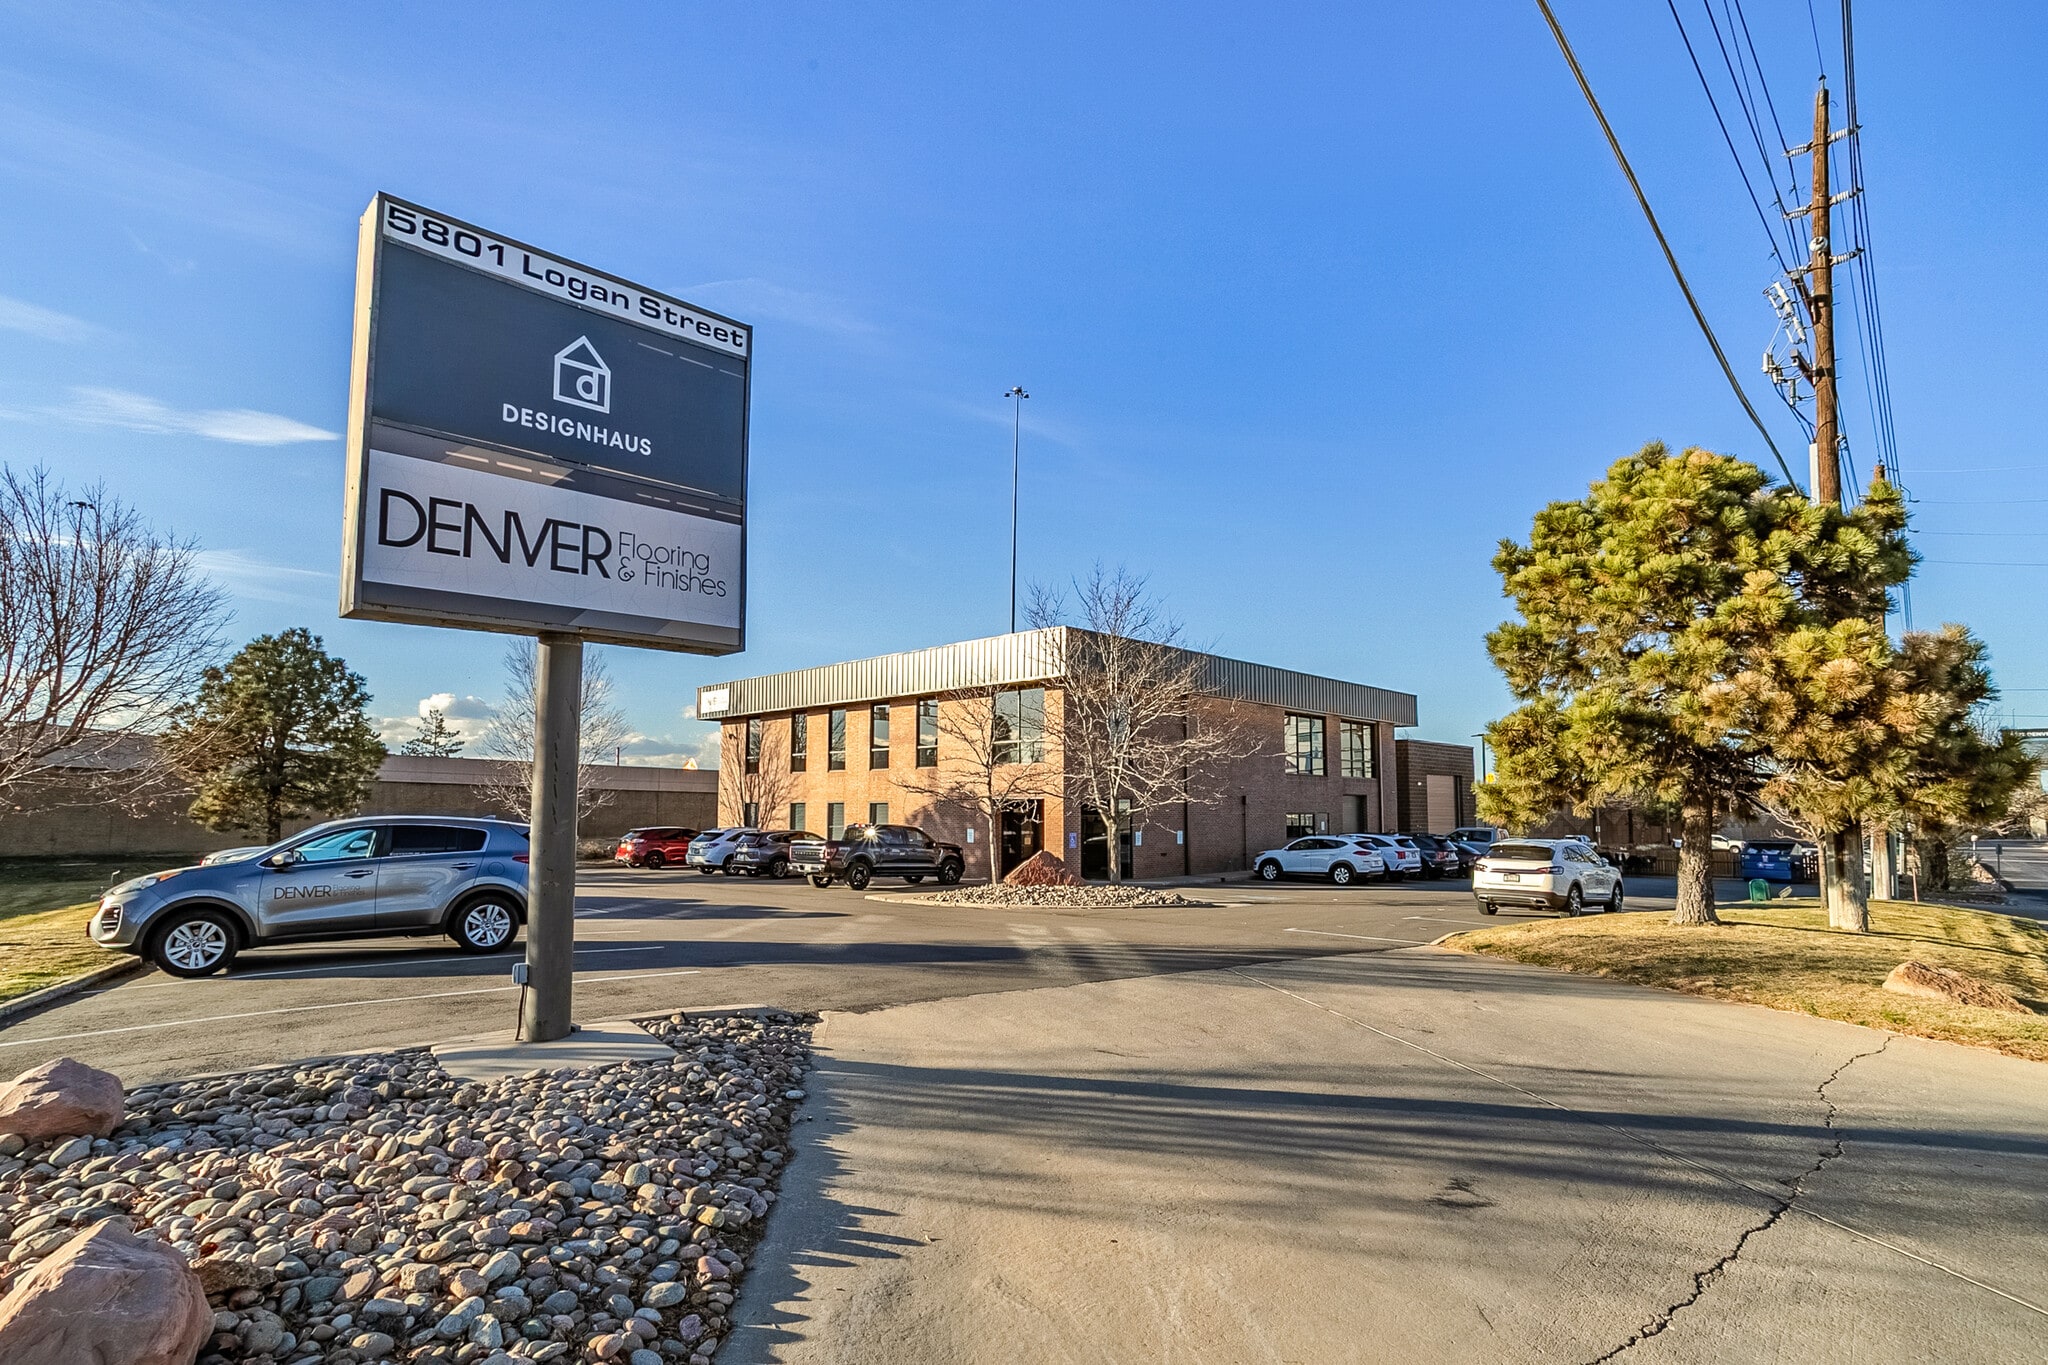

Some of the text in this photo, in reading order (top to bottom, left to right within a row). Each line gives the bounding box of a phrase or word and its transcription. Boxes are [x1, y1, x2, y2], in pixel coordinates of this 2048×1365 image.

[387, 205, 744, 348] 5801 Logan Street
[502, 403, 652, 456] DESIGNHAUS
[378, 487, 612, 580] DENVER
[619, 531, 710, 576] Flooring
[617, 556, 727, 597] & Finishes
[274, 885, 332, 900] DENVER
